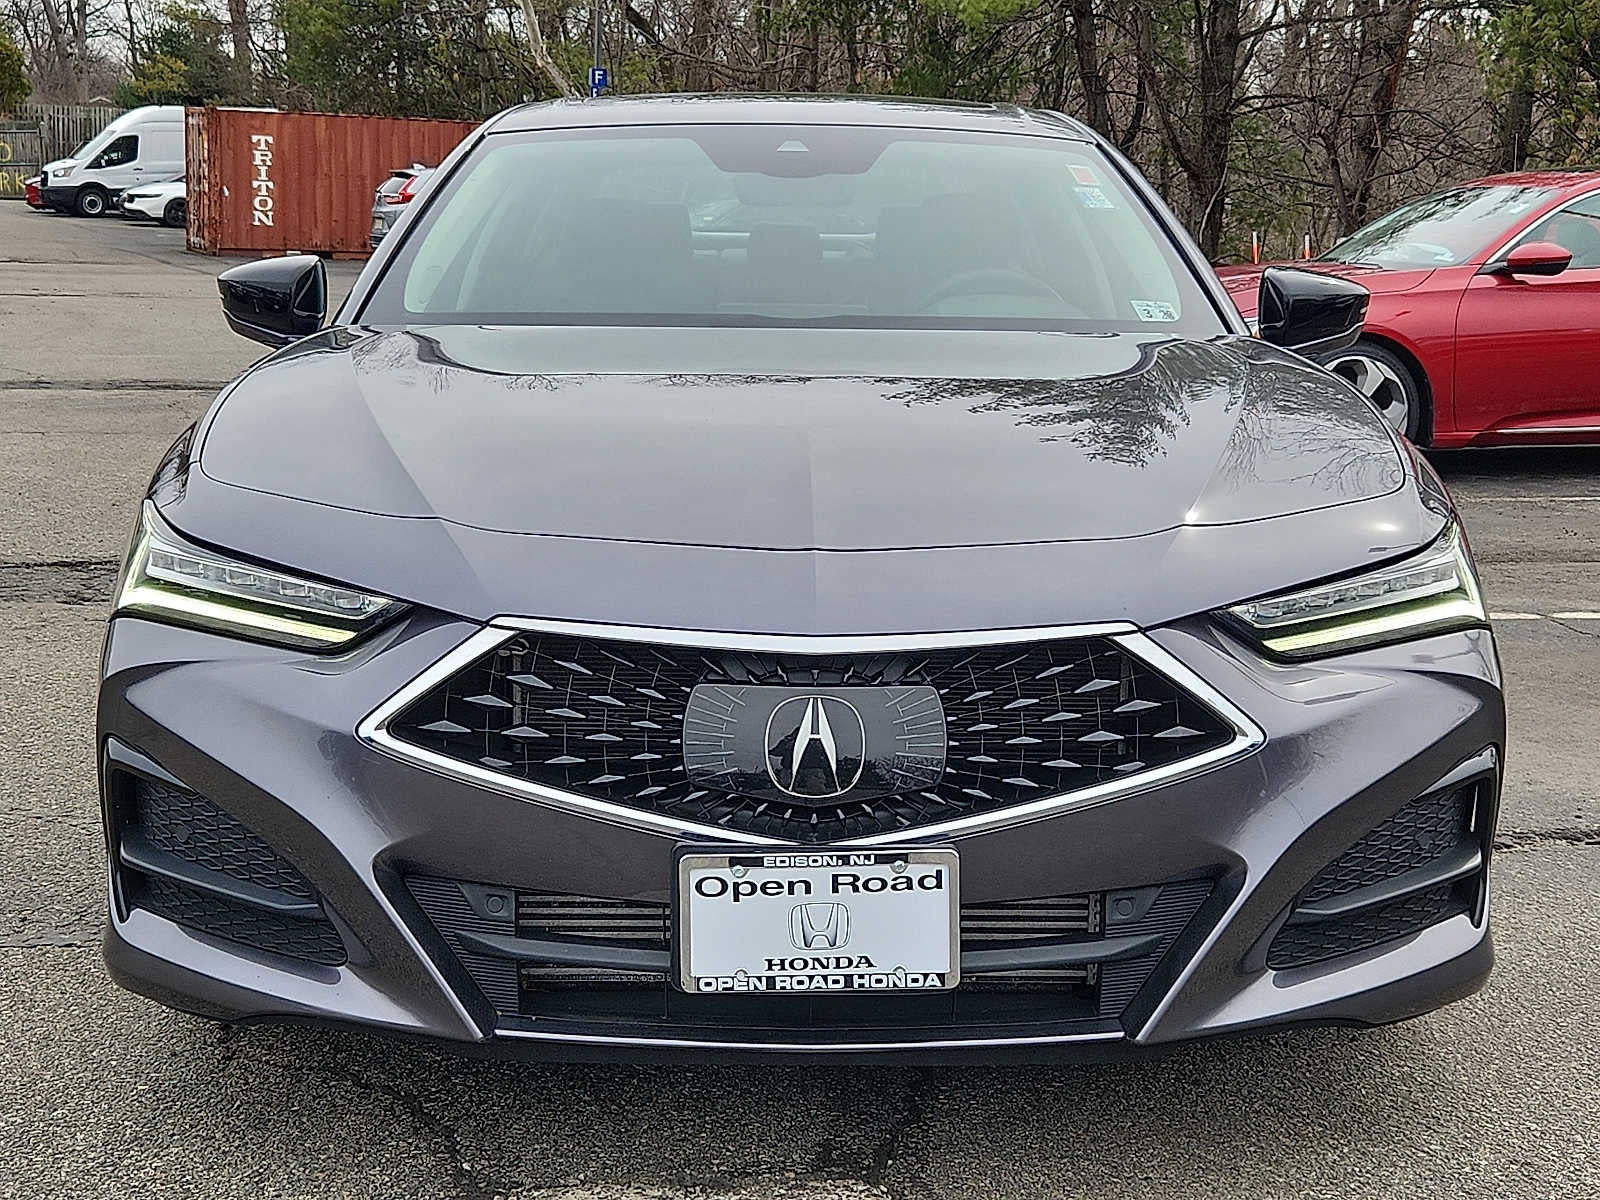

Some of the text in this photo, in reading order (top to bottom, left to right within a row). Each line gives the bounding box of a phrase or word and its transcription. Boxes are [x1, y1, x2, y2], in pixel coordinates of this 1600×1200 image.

[595, 70, 603, 84] F
[0, 172, 29, 193] RK
[251, 134, 274, 226] TRITON
[1143, 308, 1153, 319] 3
[849, 854, 875, 865] NJ
[695, 869, 943, 902] Open Road
[764, 956, 877, 972] HONDA
[699, 974, 943, 992] OPEN ROAD HONDA
